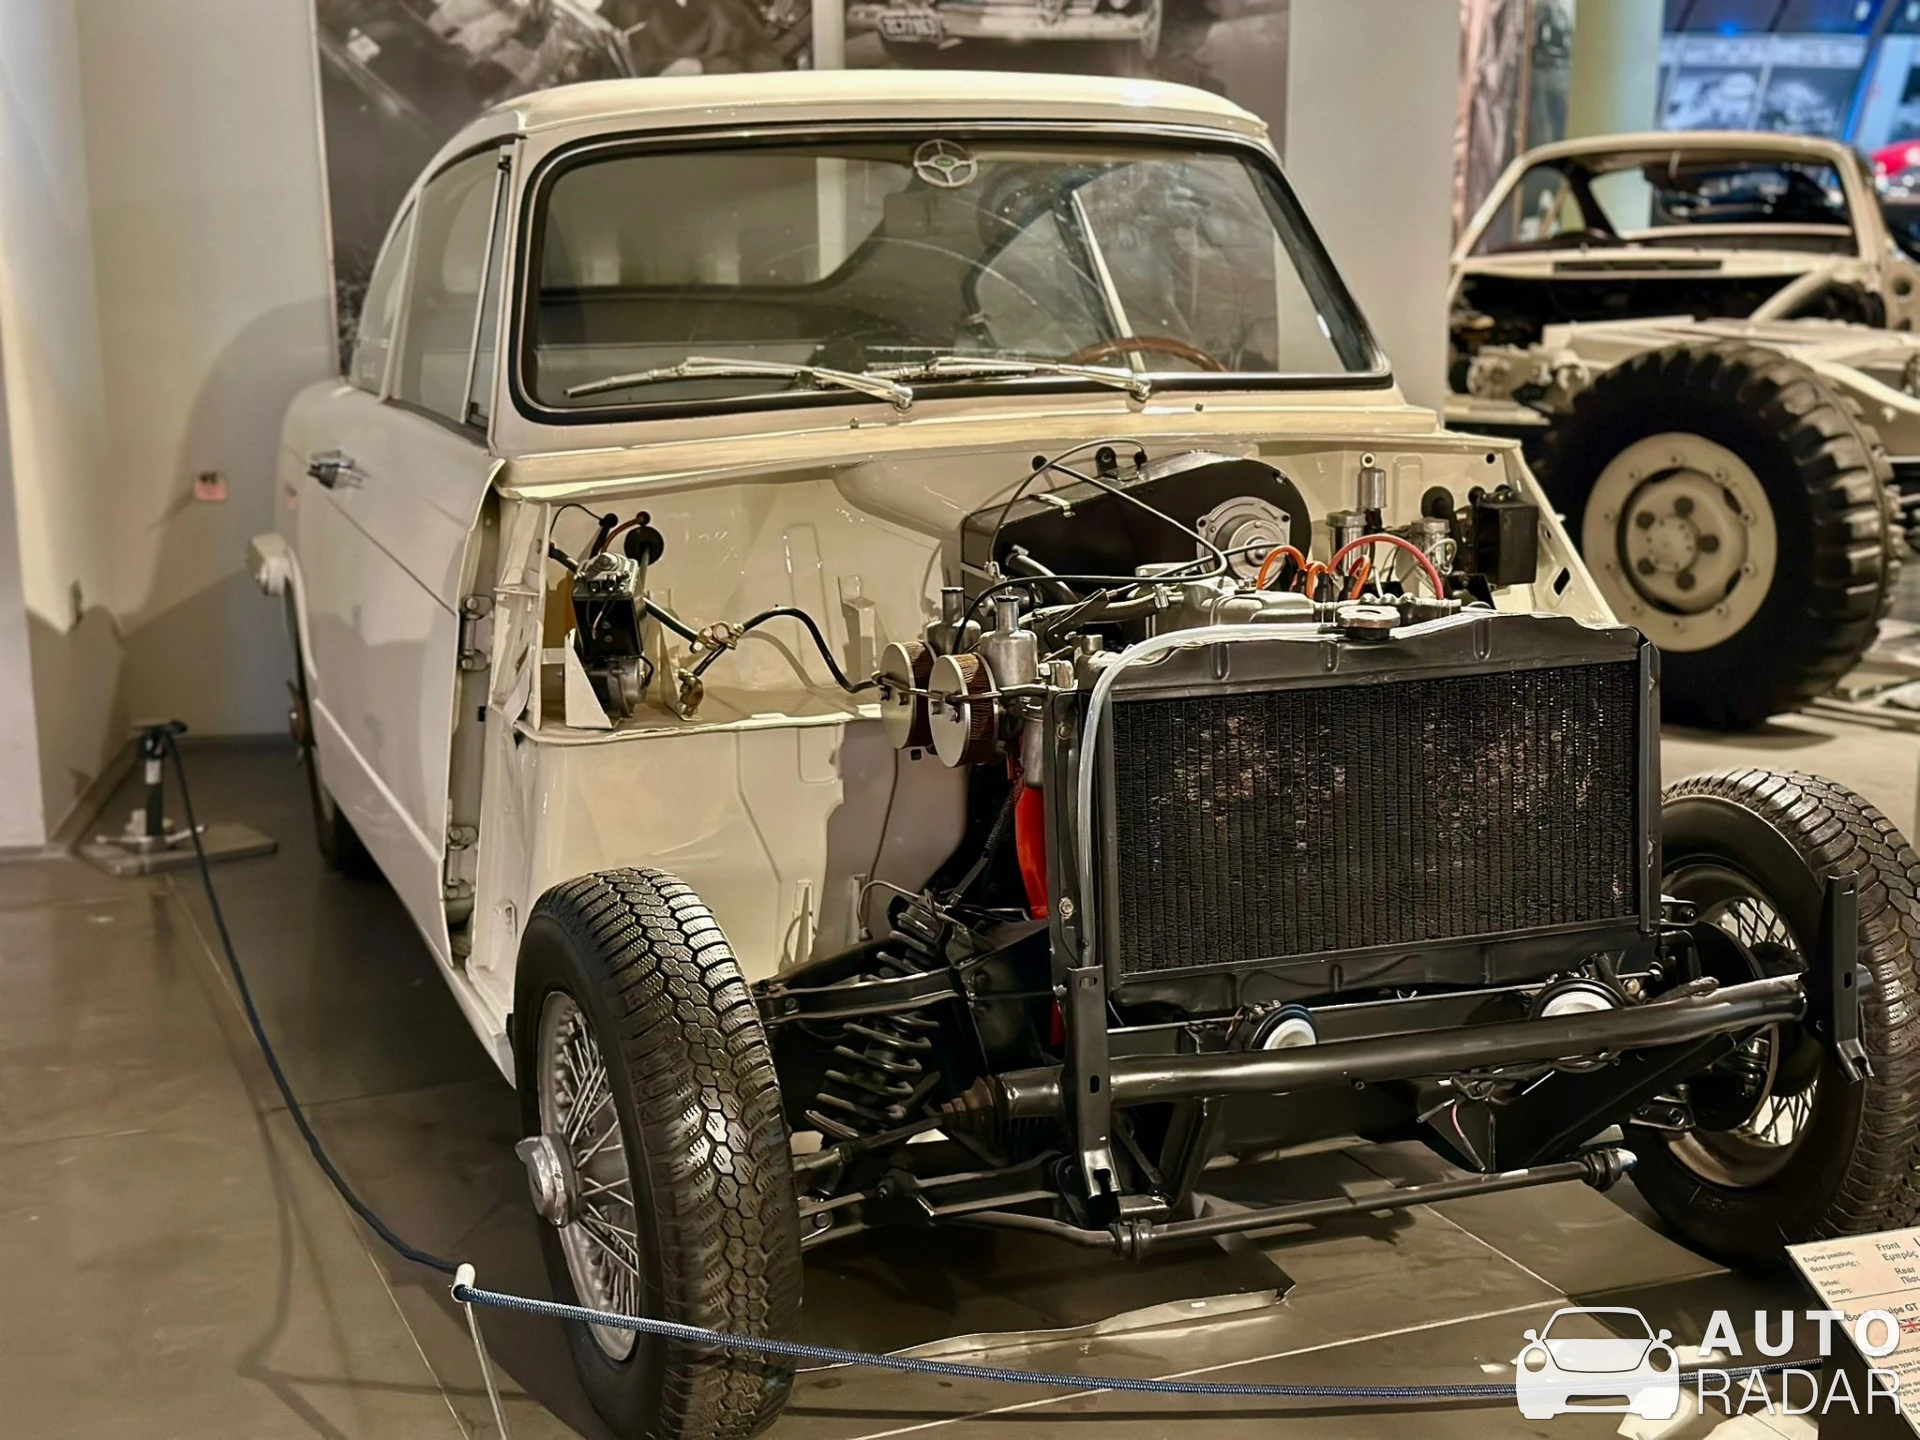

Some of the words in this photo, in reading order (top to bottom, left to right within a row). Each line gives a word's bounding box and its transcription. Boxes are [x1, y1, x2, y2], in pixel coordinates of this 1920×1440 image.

[1875, 1241, 1901, 1251] Front
[1894, 1266, 1916, 1275] Rear
[1904, 1302, 1919, 1312] GT
